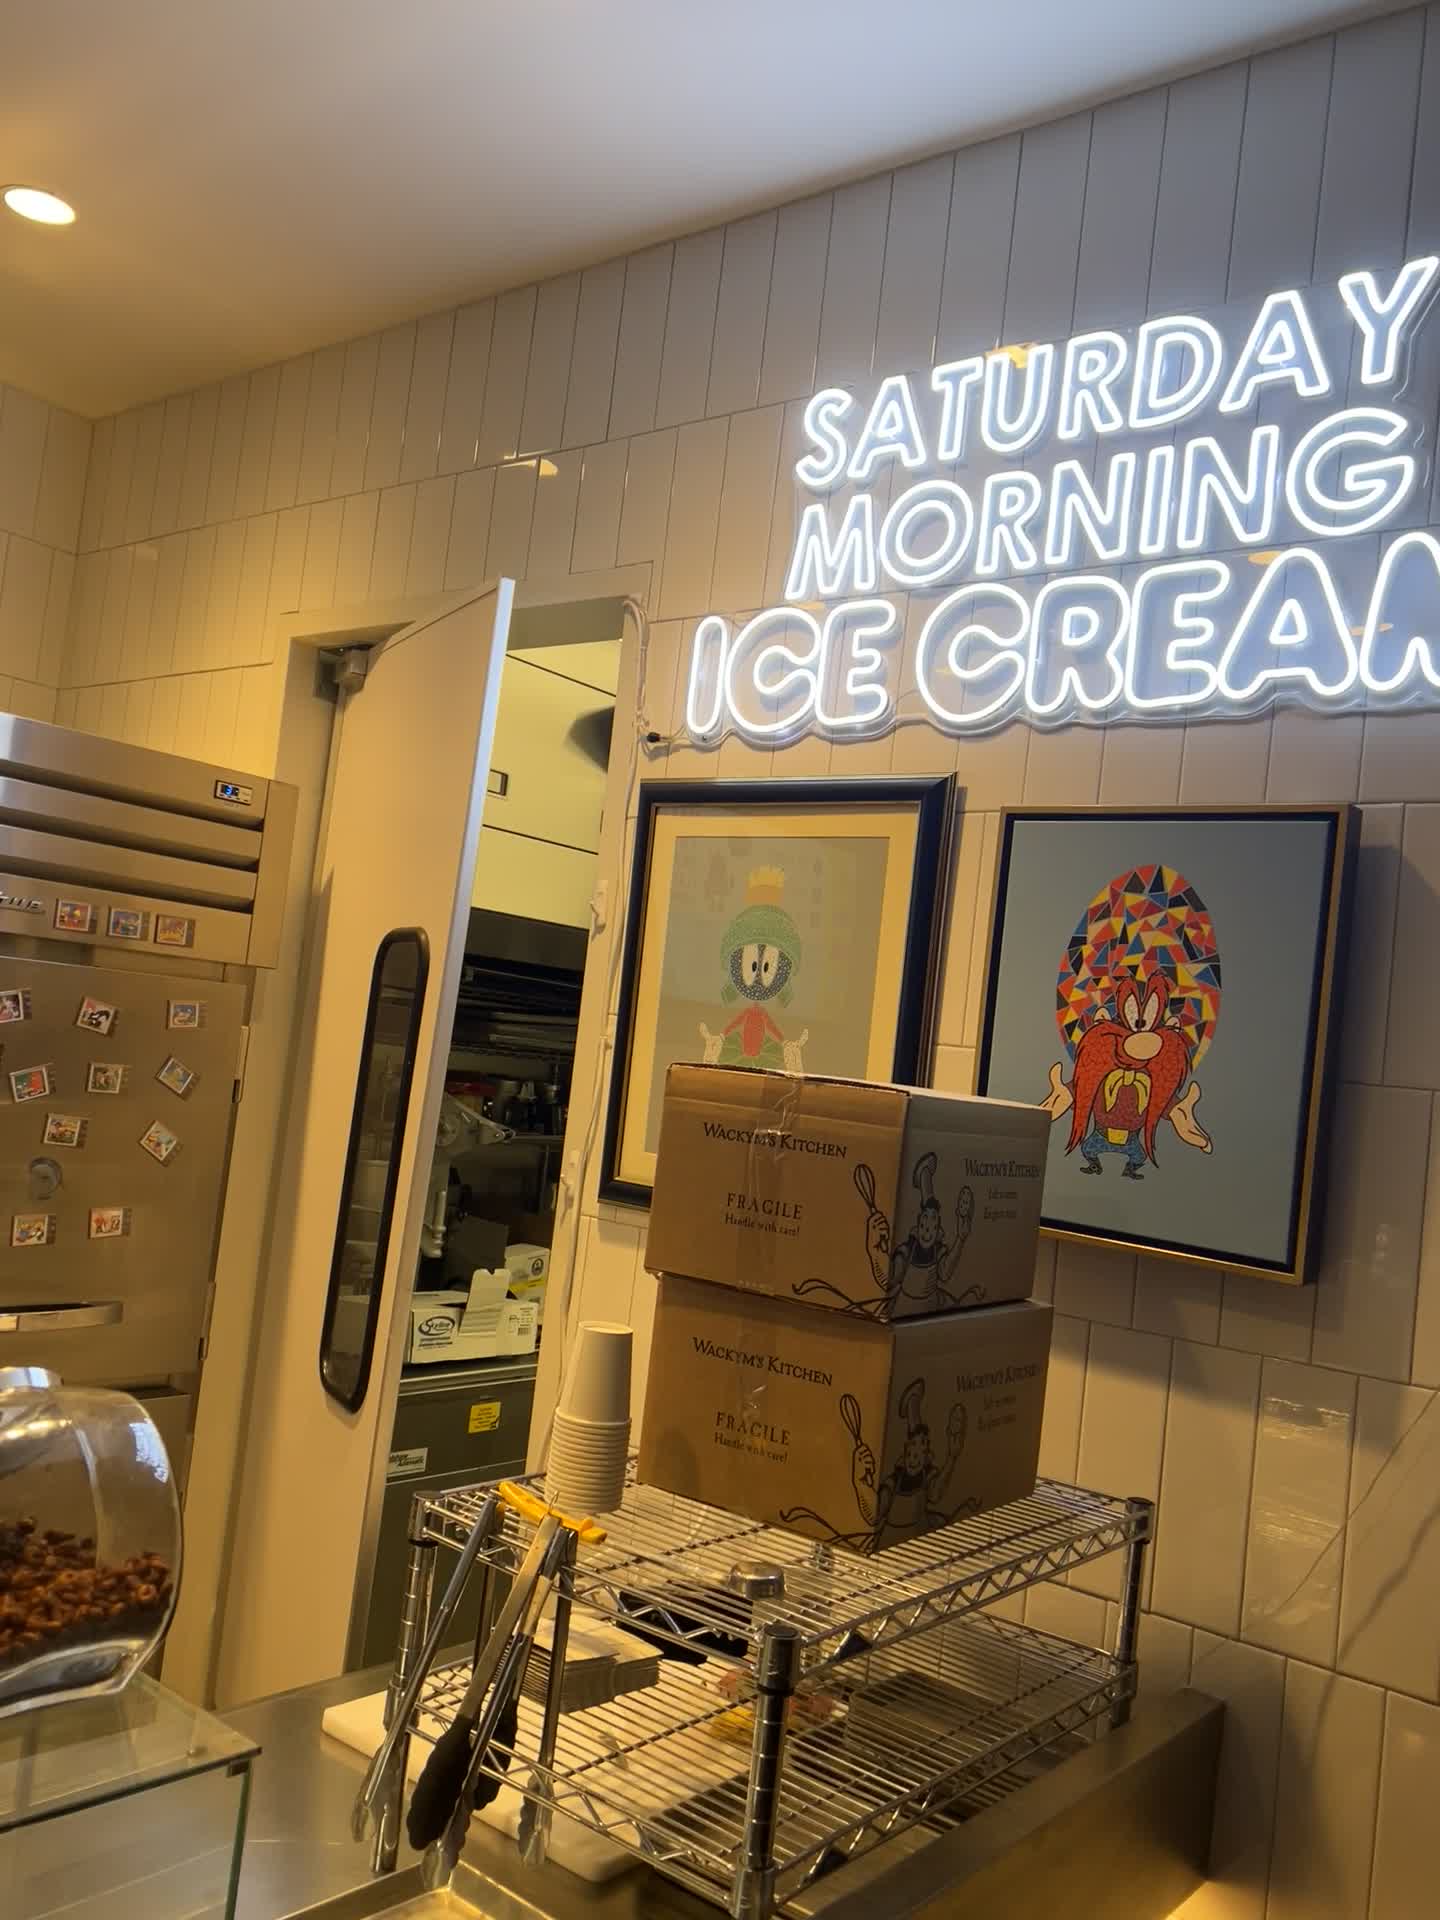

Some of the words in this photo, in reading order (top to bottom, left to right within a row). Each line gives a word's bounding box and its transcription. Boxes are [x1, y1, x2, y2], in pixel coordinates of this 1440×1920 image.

[795, 256, 1439, 487] SATURDAY
[785, 407, 1414, 601] MORNING
[687, 600, 897, 736] ICE
[703, 1122, 776, 1148] WACKYM'S
[780, 1134, 848, 1159] KITCHEN
[726, 1192, 803, 1220] FRAGILE
[692, 1336, 764, 1369] WACKYM'S
[767, 1355, 833, 1387] KITCHEN
[715, 1411, 792, 1446] FRAGILE
